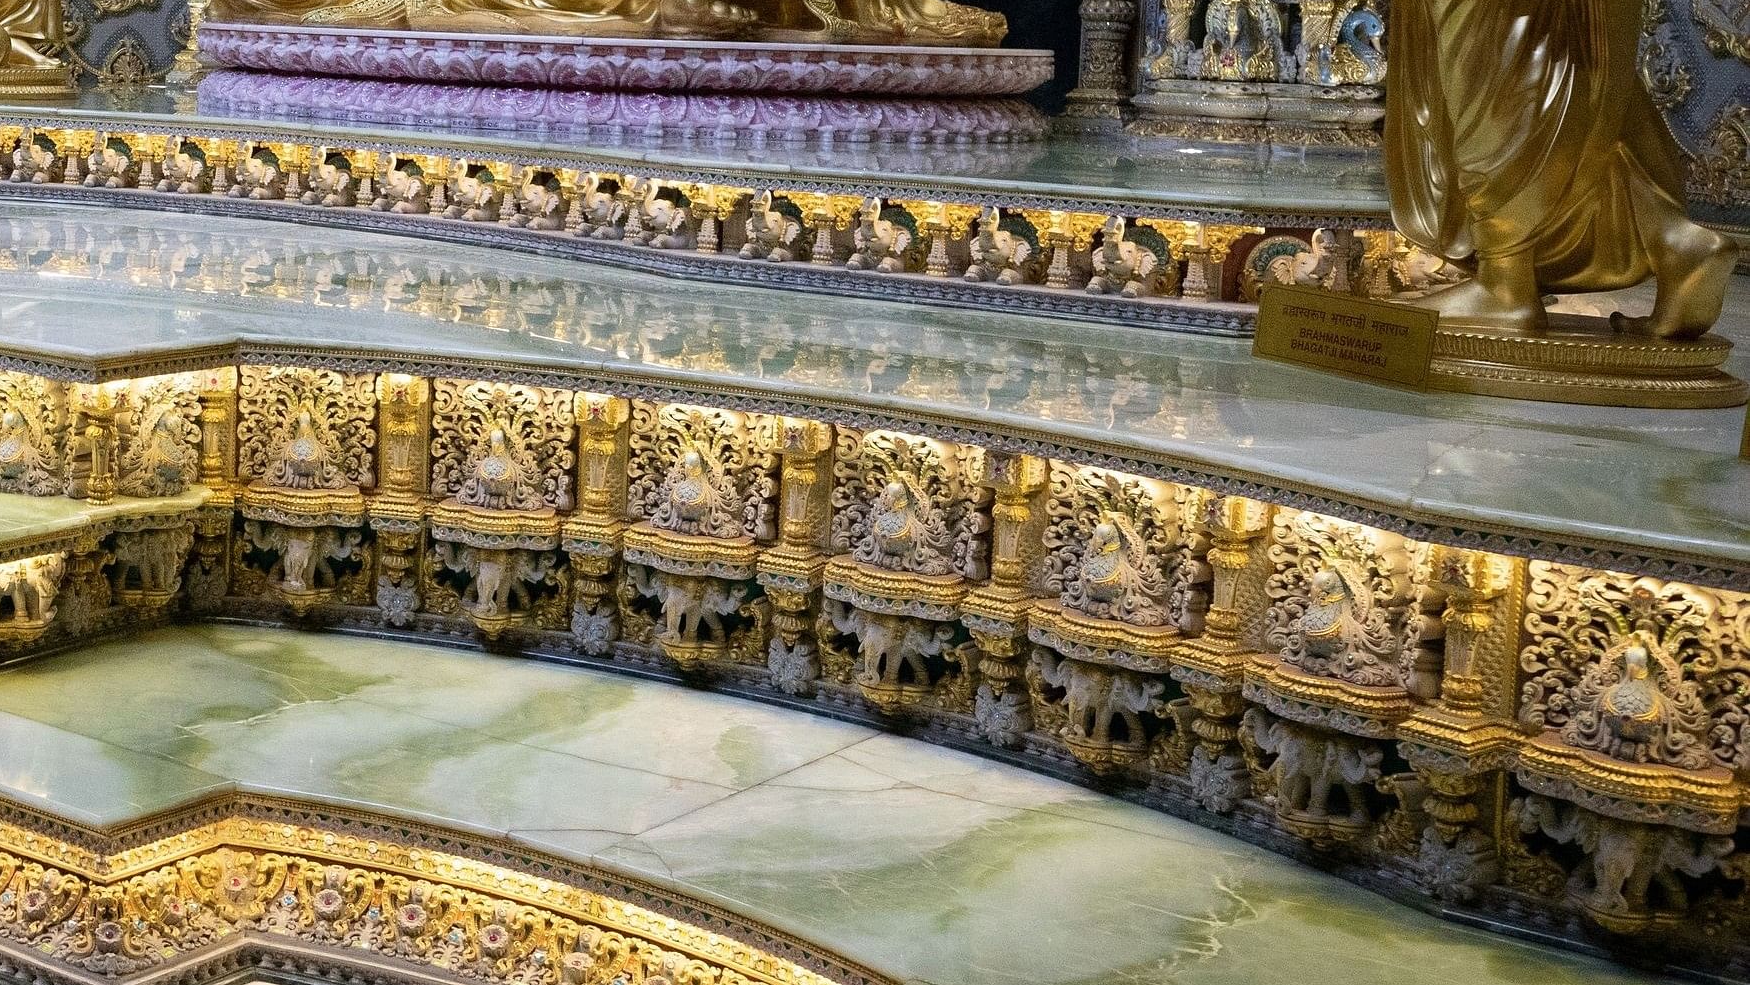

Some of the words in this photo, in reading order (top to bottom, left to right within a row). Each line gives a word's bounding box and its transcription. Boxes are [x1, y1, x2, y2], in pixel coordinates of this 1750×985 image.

[1331, 314, 1366, 330] भगतजी
[1371, 320, 1410, 337] महाराज
[1299, 328, 1383, 352] BRAHMASWARUP
[1290, 339, 1338, 358] BHAGATJI
[1339, 348, 1387, 367] MAHARAJ
